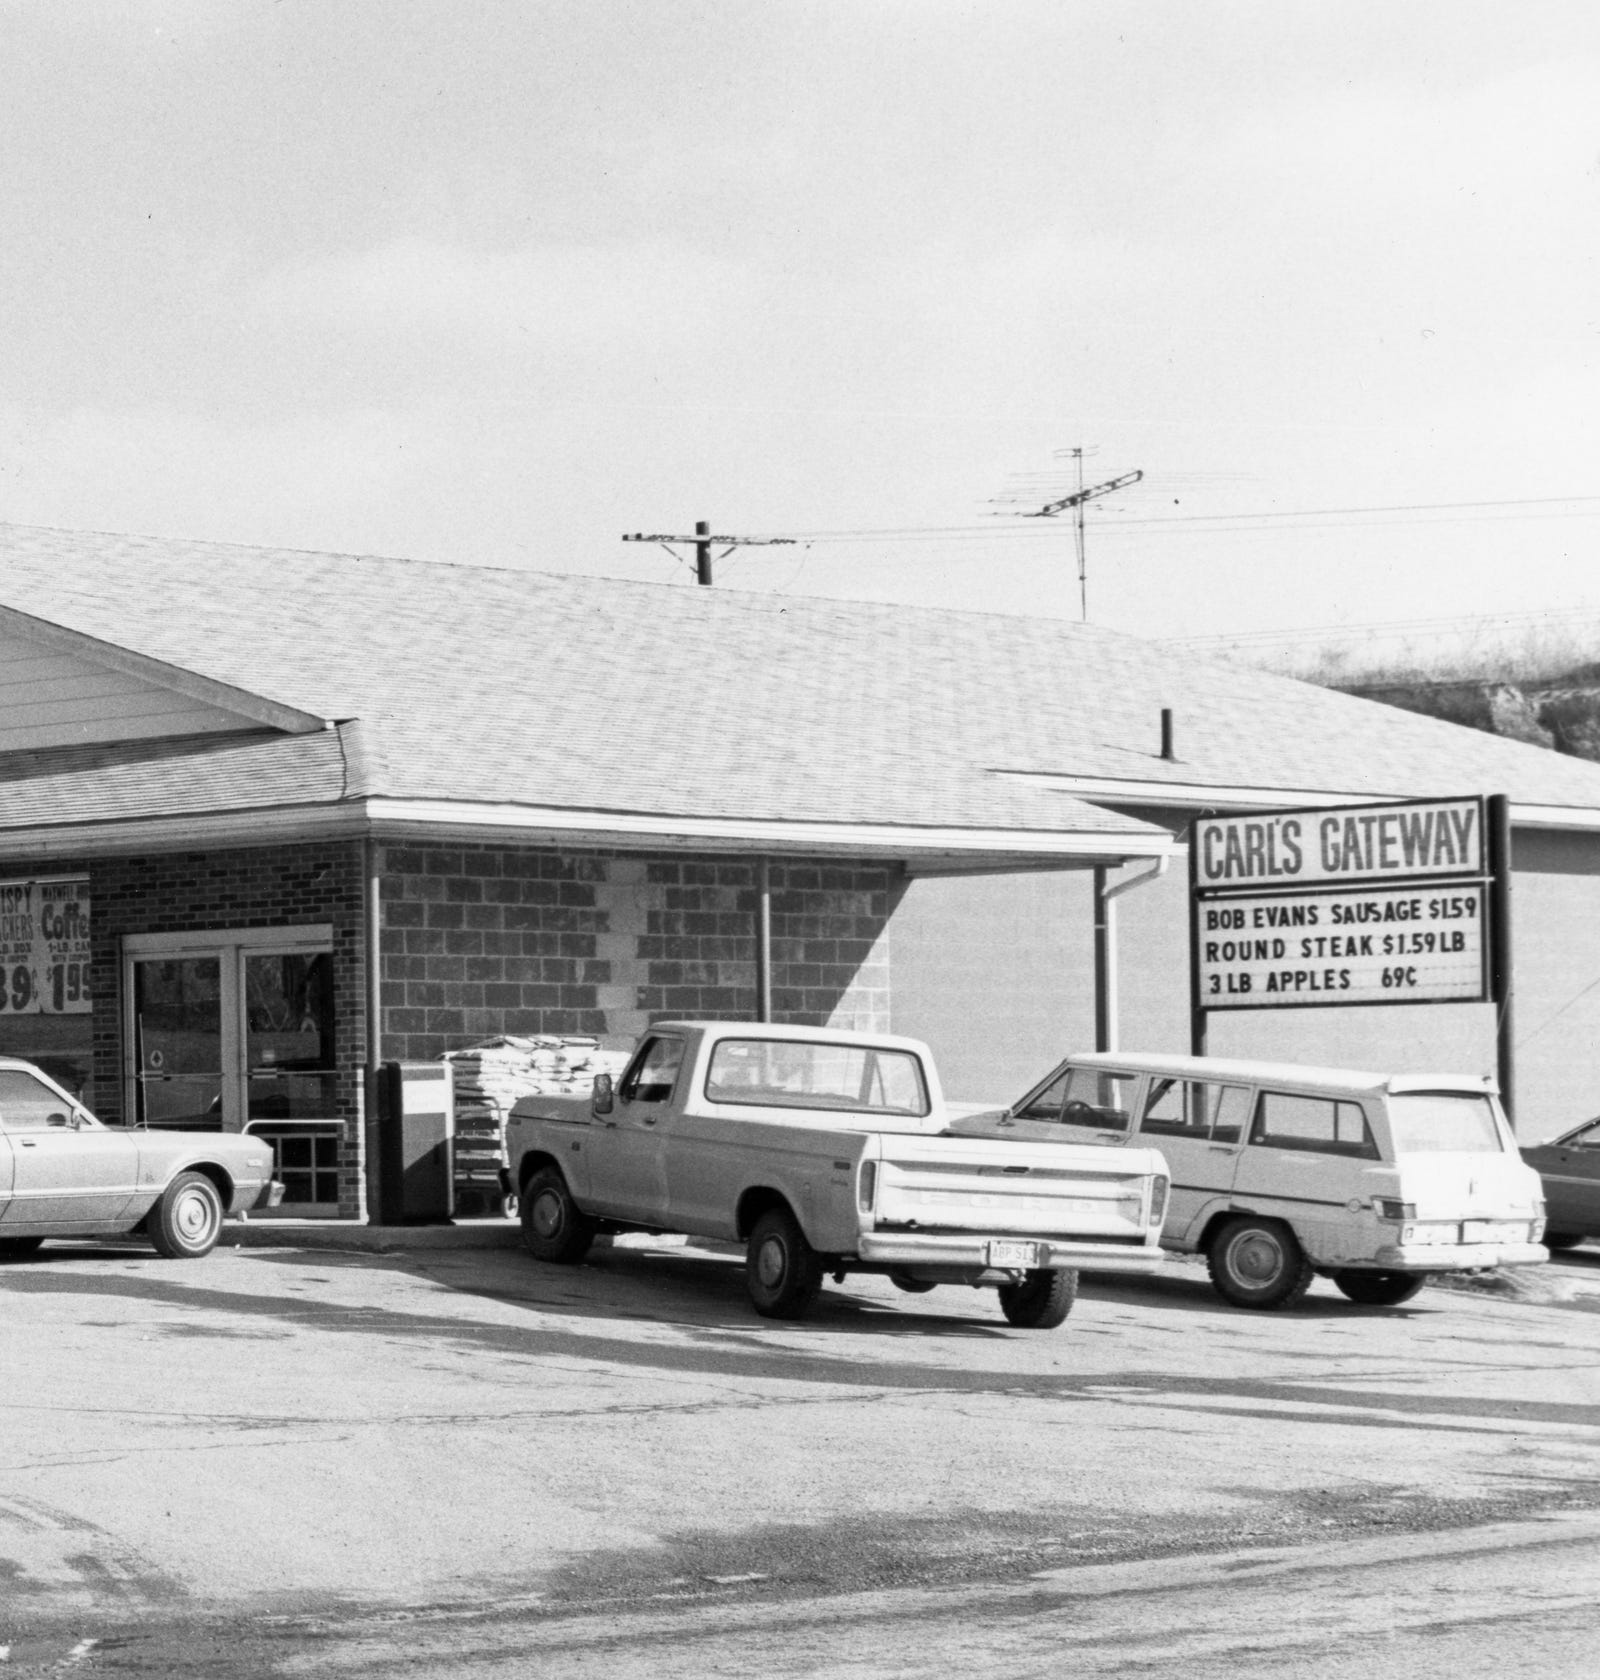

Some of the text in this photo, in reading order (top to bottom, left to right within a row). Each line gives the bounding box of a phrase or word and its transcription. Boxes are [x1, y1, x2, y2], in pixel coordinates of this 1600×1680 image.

[1204, 808, 1475, 880] CARL'S GATEWAY
[1206, 909, 1246, 931] BOB
[1253, 904, 1319, 928] EVANS
[1331, 898, 1422, 925] SAUSAGE
[1205, 931, 1466, 962] ROUND STEAK $1.59 LB
[1209, 973, 1222, 994] 3
[1227, 972, 1252, 994] LB
[1265, 968, 1351, 992] APPLES
